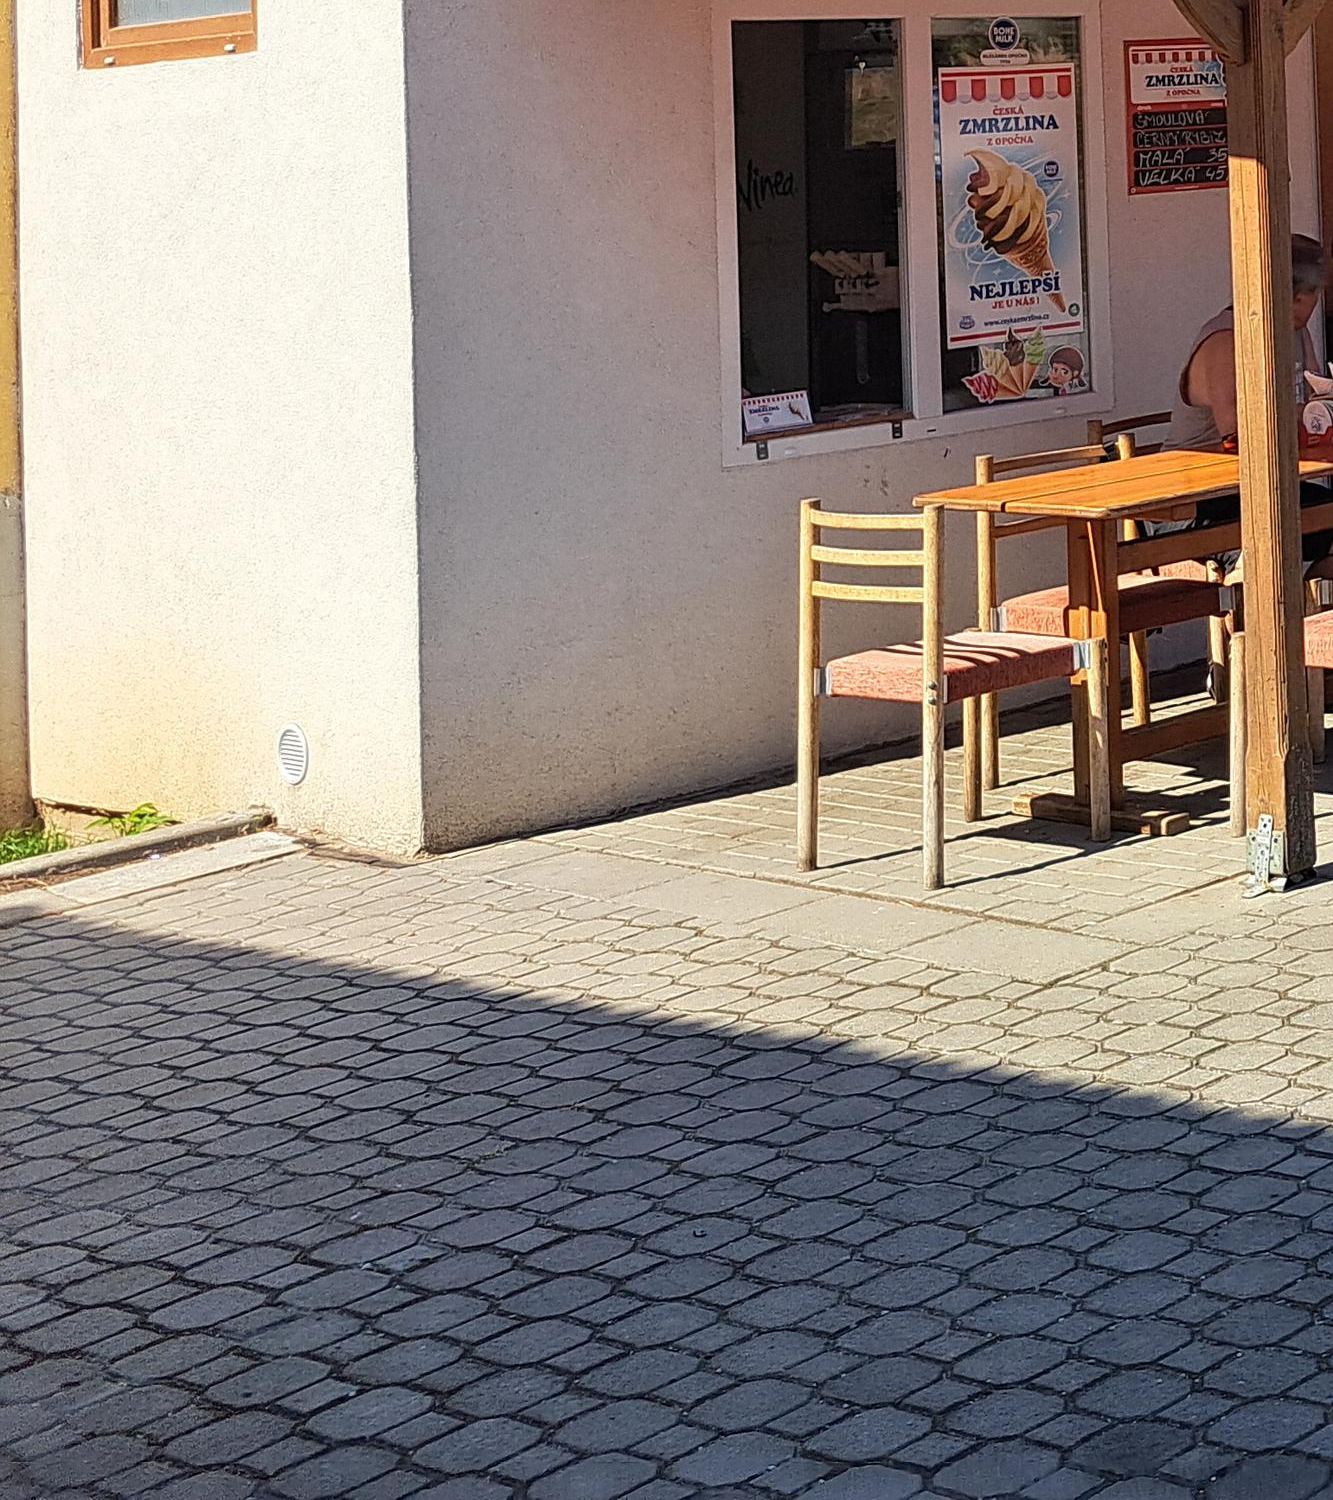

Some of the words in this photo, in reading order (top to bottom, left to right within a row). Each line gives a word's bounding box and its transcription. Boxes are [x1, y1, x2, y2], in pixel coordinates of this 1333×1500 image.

[1145, 72, 1220, 88] ZMRZLINA
[992, 105, 1024, 116] ČESKÁ
[959, 114, 1060, 135] ZMRZLINA
[986, 138, 994, 146] Z
[995, 133, 1034, 146] OPOČNA
[969, 271, 1061, 301] NEJLEPŠÍ
[992, 300, 1005, 309] JE
[1005, 298, 1013, 307] U
